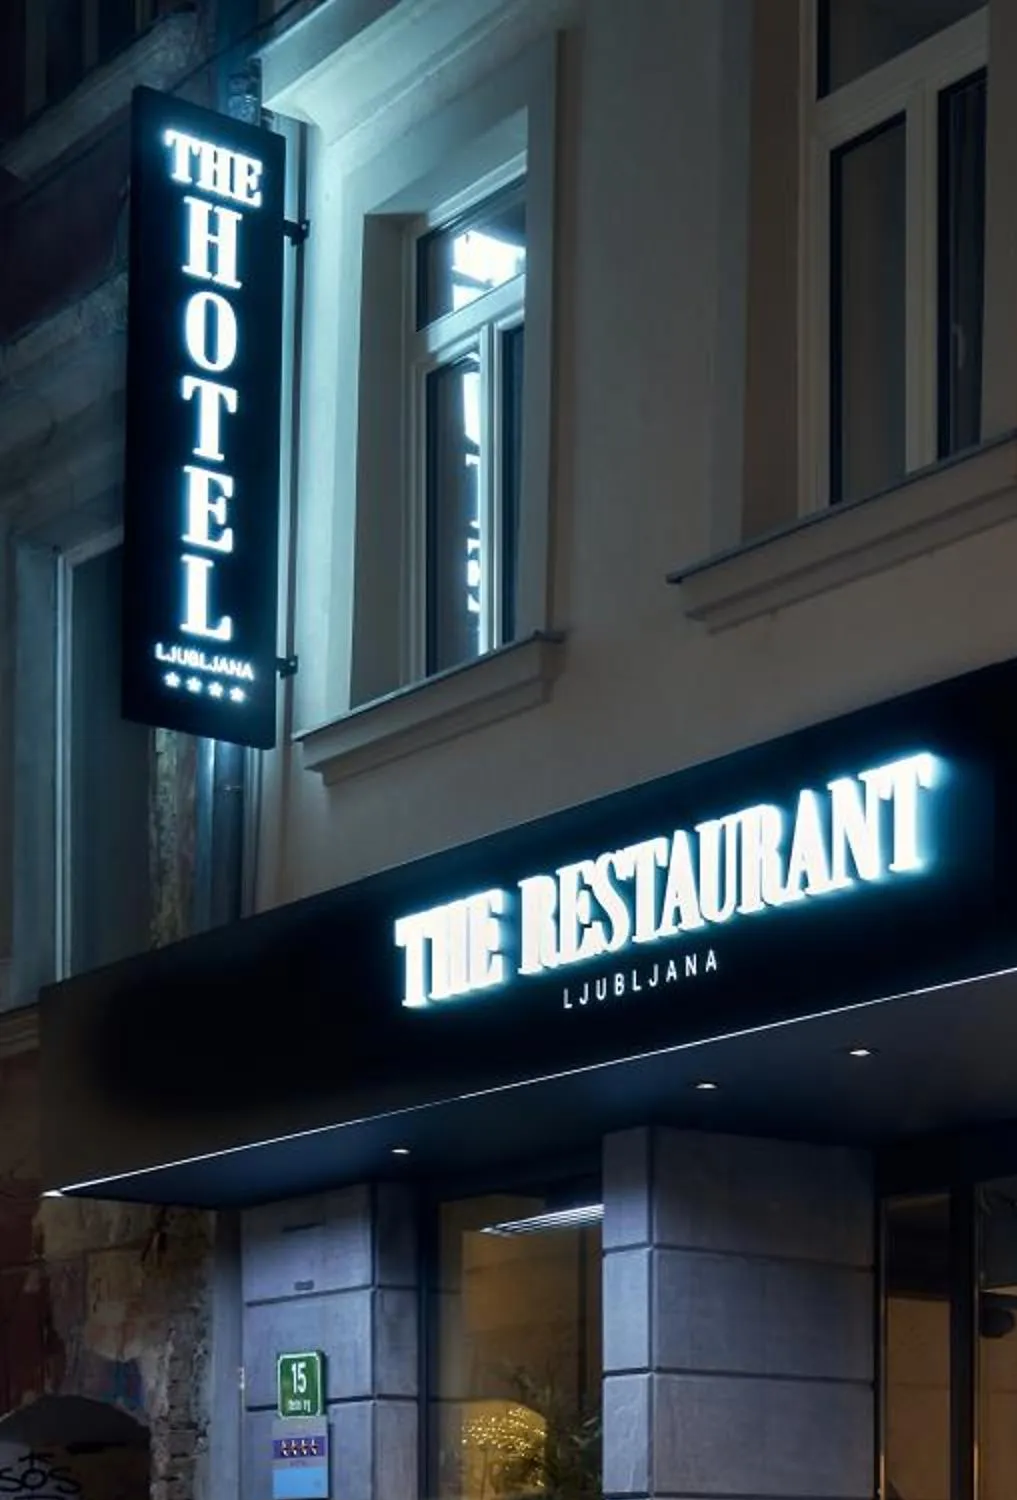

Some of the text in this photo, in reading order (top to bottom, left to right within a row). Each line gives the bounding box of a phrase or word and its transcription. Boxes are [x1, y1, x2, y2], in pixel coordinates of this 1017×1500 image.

[164, 129, 263, 208] THE
[180, 196, 243, 642] HOTEL
[155, 643, 254, 681] LJUBLJANA
[394, 752, 937, 1008] THE RESTAURANT
[563, 949, 719, 1009] LJUBLJANA
[291, 1361, 307, 1394] 15
